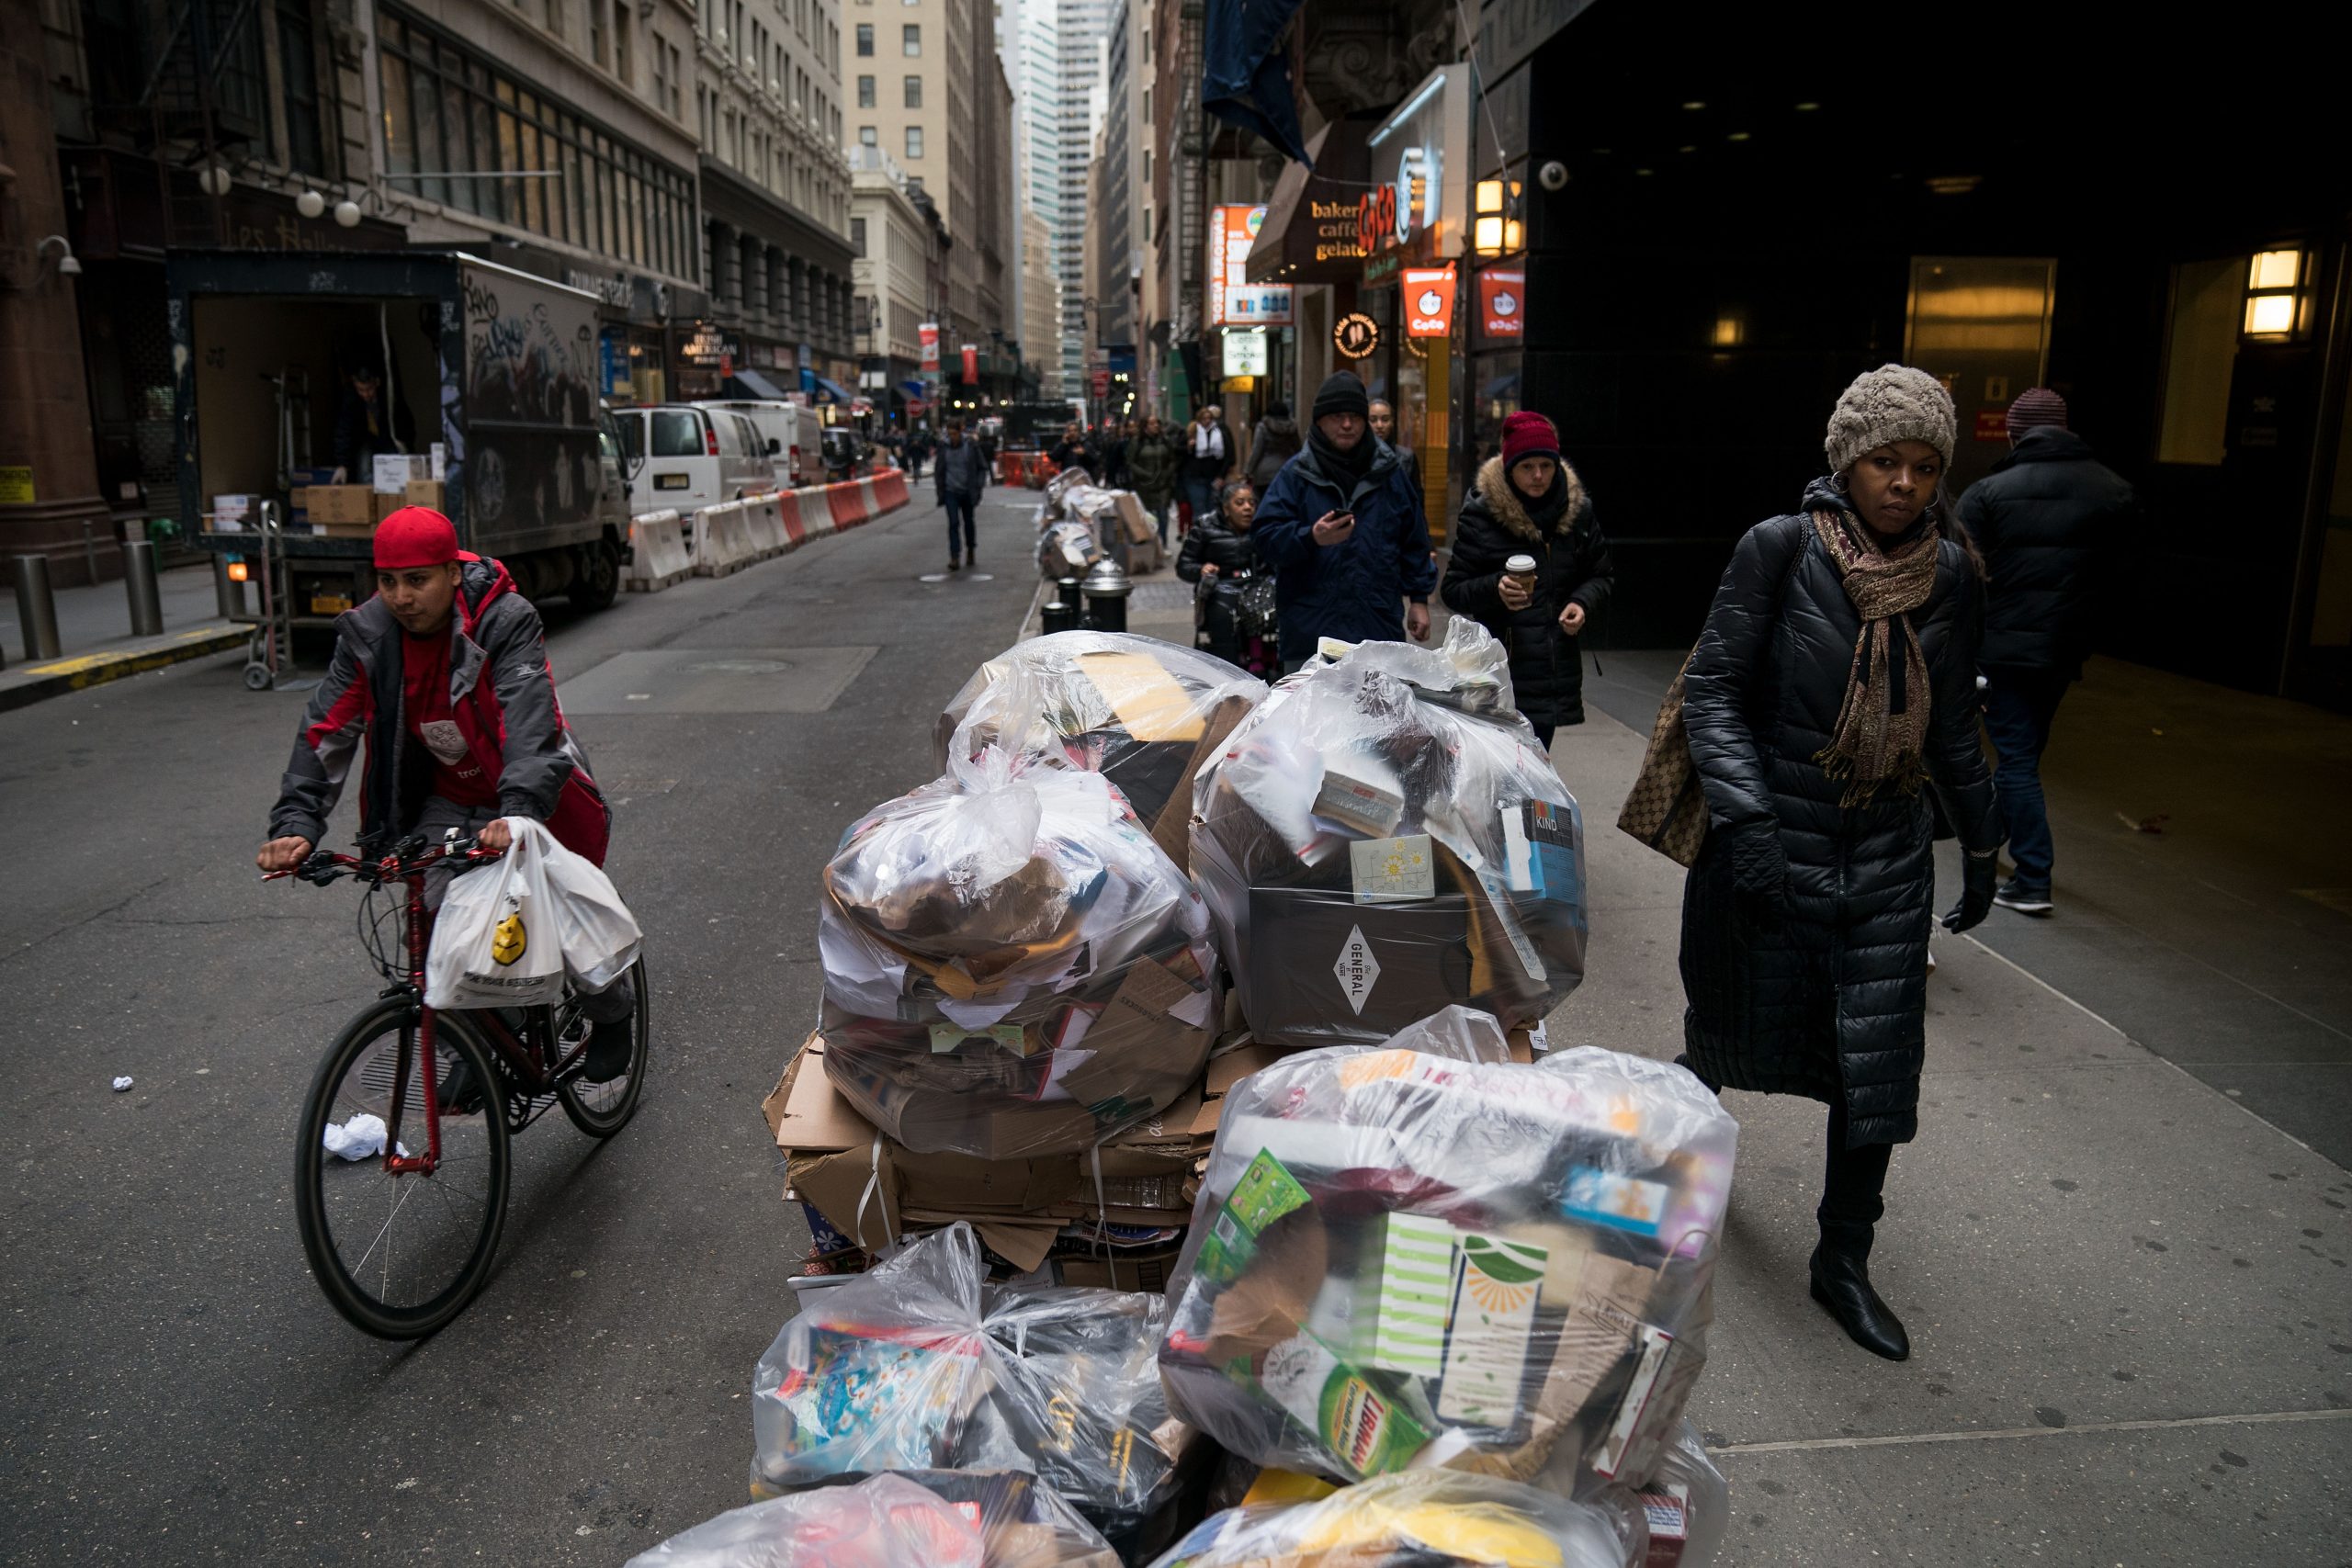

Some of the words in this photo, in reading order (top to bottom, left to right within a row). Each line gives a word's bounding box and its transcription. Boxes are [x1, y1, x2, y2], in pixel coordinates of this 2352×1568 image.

[1311, 201, 1359, 218] baker
[1412, 319, 1445, 331] CoCo
[1535, 817, 1557, 831] KIND
[1351, 943, 1363, 997] GENERAL
[1351, 1391, 1384, 1469] LIBMAN
